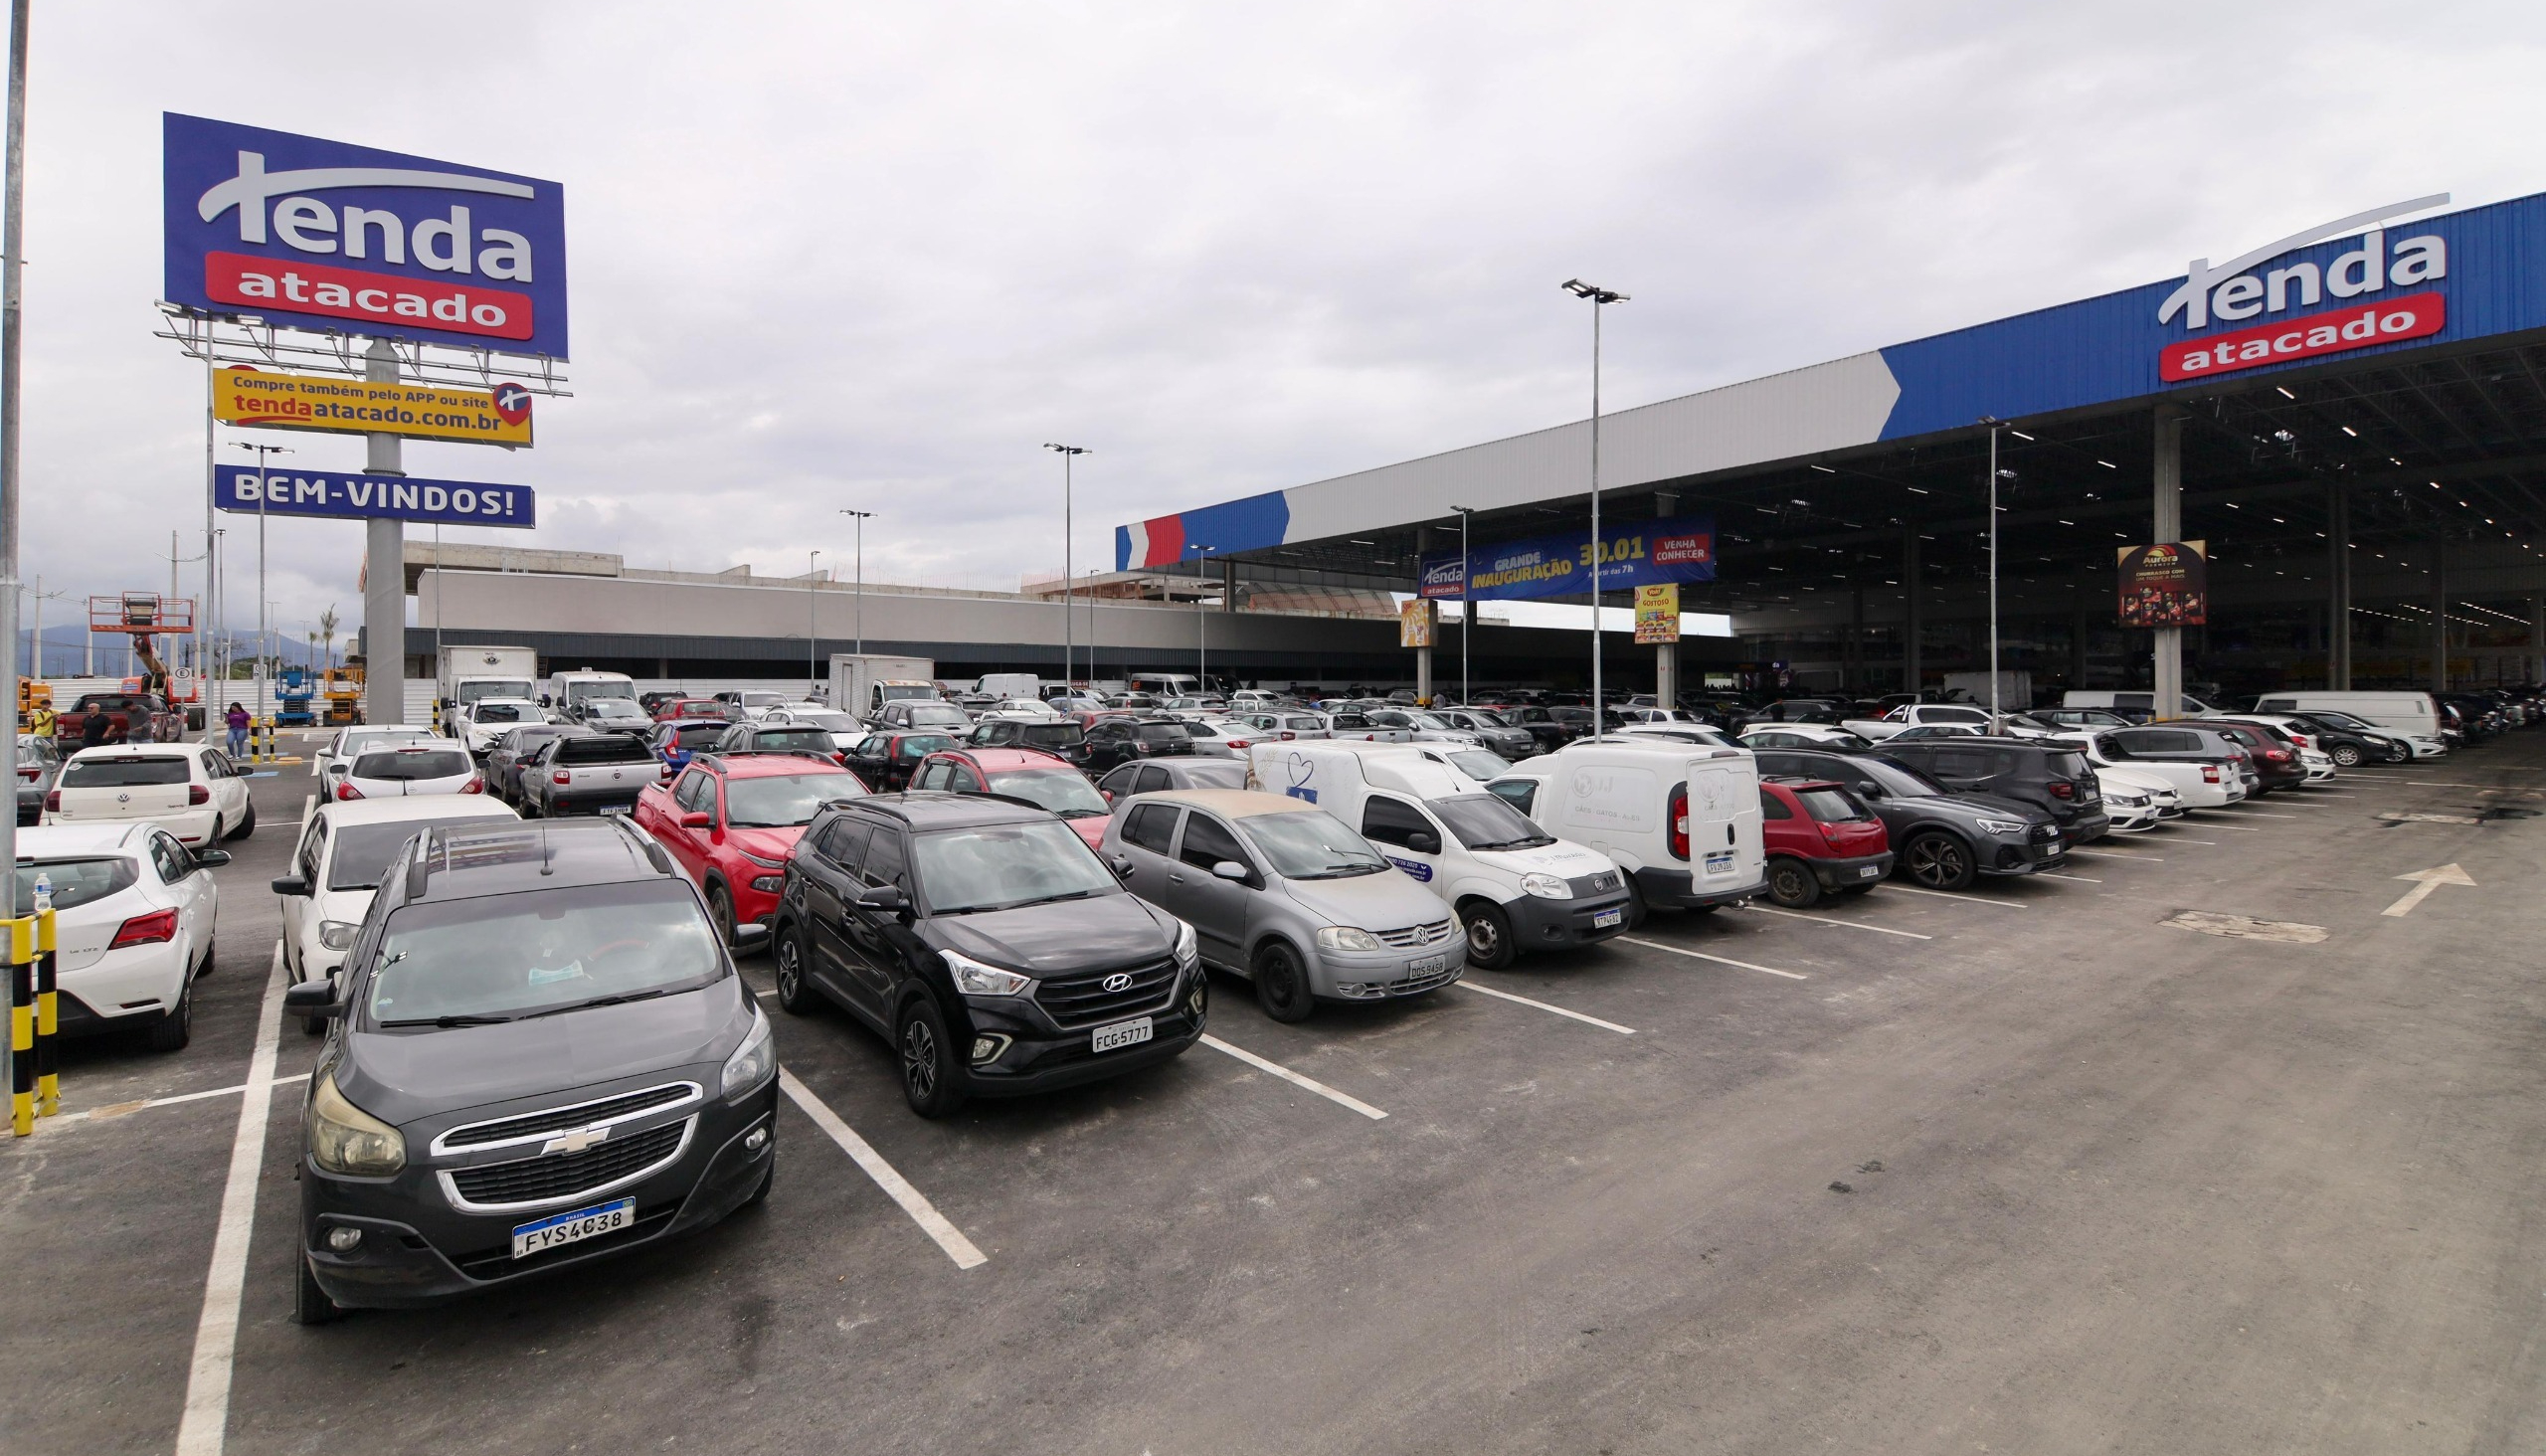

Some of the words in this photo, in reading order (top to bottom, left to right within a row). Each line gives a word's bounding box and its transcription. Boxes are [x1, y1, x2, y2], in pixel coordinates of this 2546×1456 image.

[238, 272, 507, 327] atacado
[2181, 310, 2417, 372] atacado
[233, 376, 295, 394] Compre
[299, 382, 364, 398] também
[369, 389, 401, 402] pelo
[406, 391, 436, 404] APP
[440, 396, 458, 407] ou
[462, 396, 489, 409] site
[234, 394, 502, 432] tendaatacado.com.br
[235, 473, 514, 516] BEM-VINDOS!
[1579, 536, 1645, 566] 30.01
[1656, 549, 1705, 562] CONHECER
[1664, 539, 1697, 550] VENHA
[2143, 555, 2178, 564] Aurora
[1472, 558, 1572, 589] INAUGURAÇÃO
[1495, 551, 1541, 572] GRANDE
[1622, 565, 1634, 574] 7h
[1427, 586, 1459, 595] atacado
